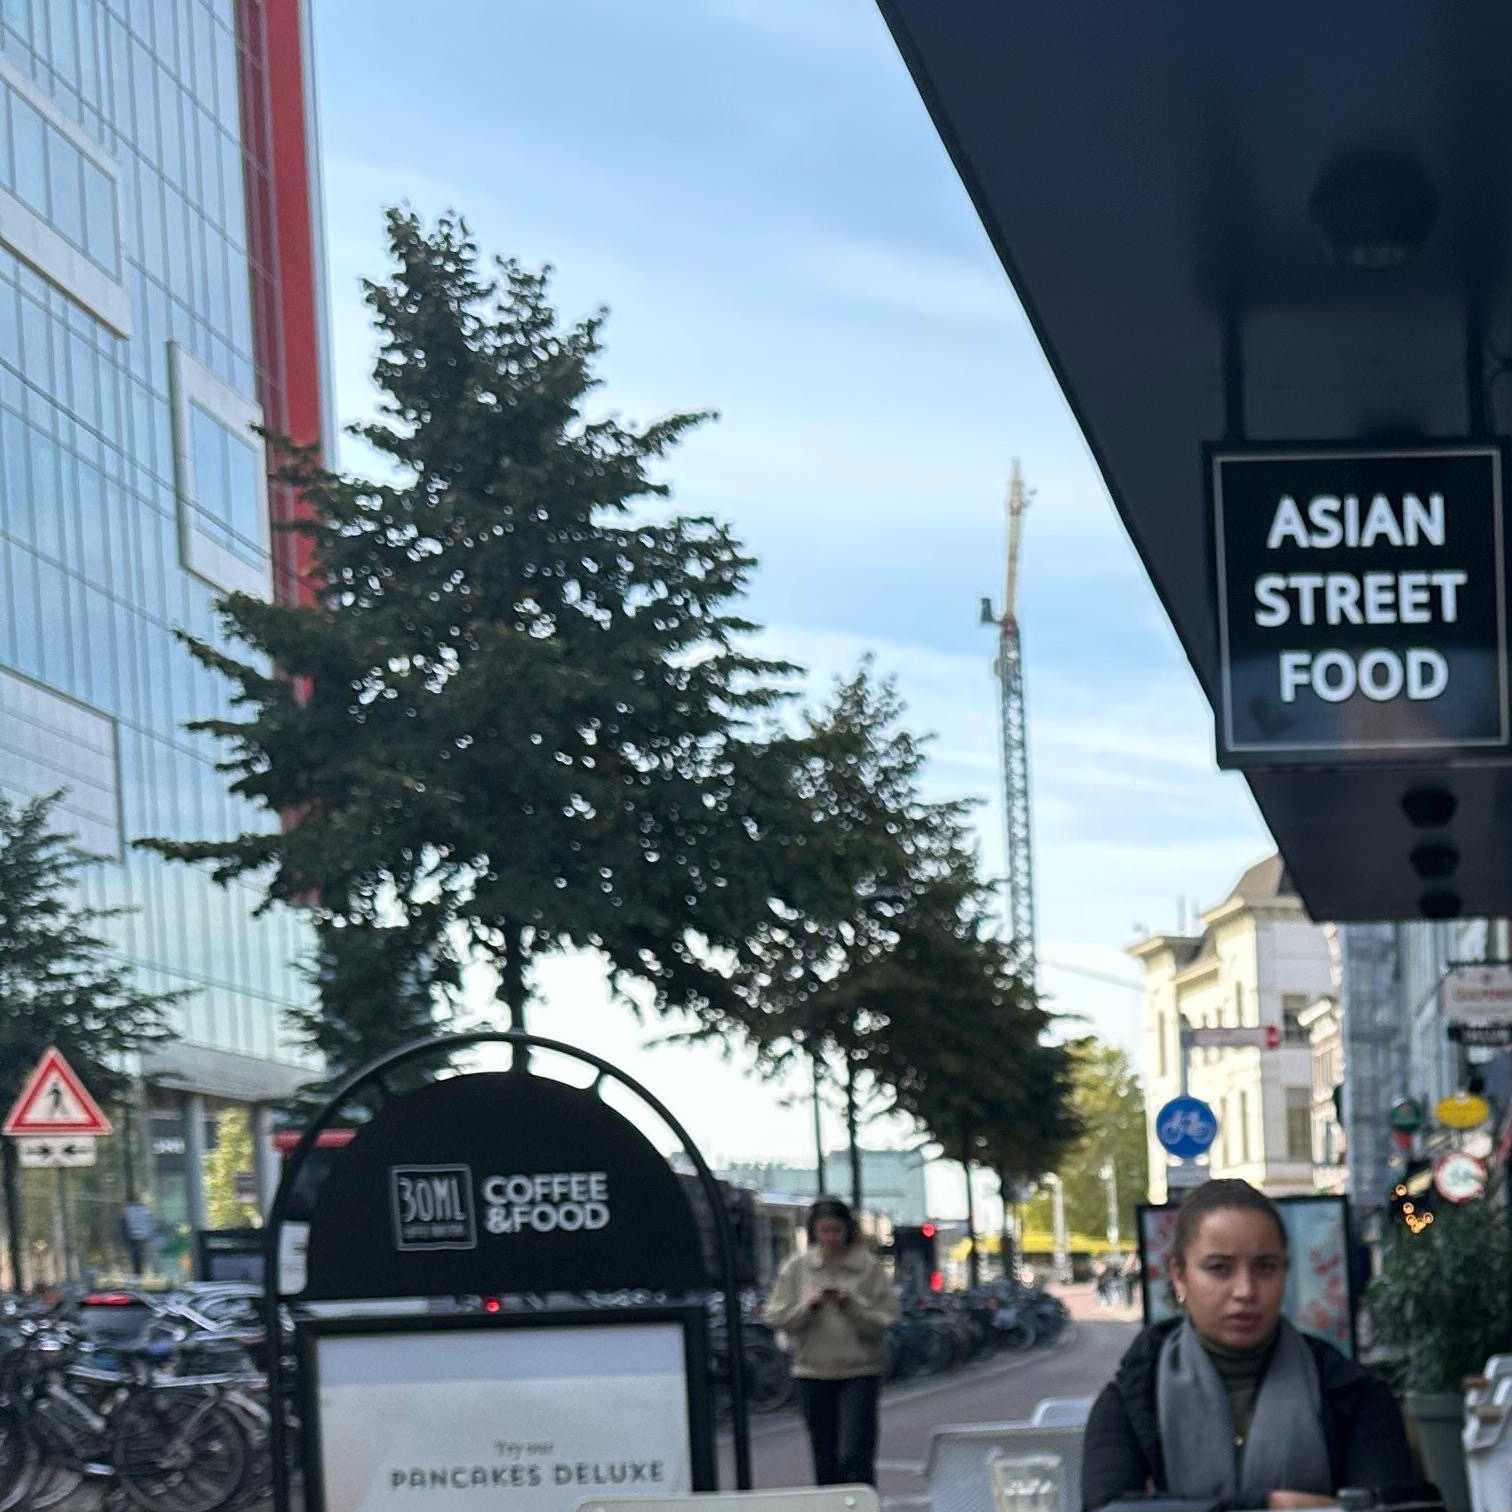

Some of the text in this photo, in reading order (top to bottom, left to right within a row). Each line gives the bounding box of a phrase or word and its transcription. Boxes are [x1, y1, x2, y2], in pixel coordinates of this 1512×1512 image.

[1266, 492, 1446, 549] ASIAN
[1254, 569, 1468, 627] STREET
[1278, 647, 1450, 702] FOOD
[399, 1176, 466, 1223] 30ML
[483, 1172, 609, 1205] COFFEE
[485, 1202, 611, 1234] &FOOD
[391, 1460, 665, 1490] PANCAKES DELUXE
